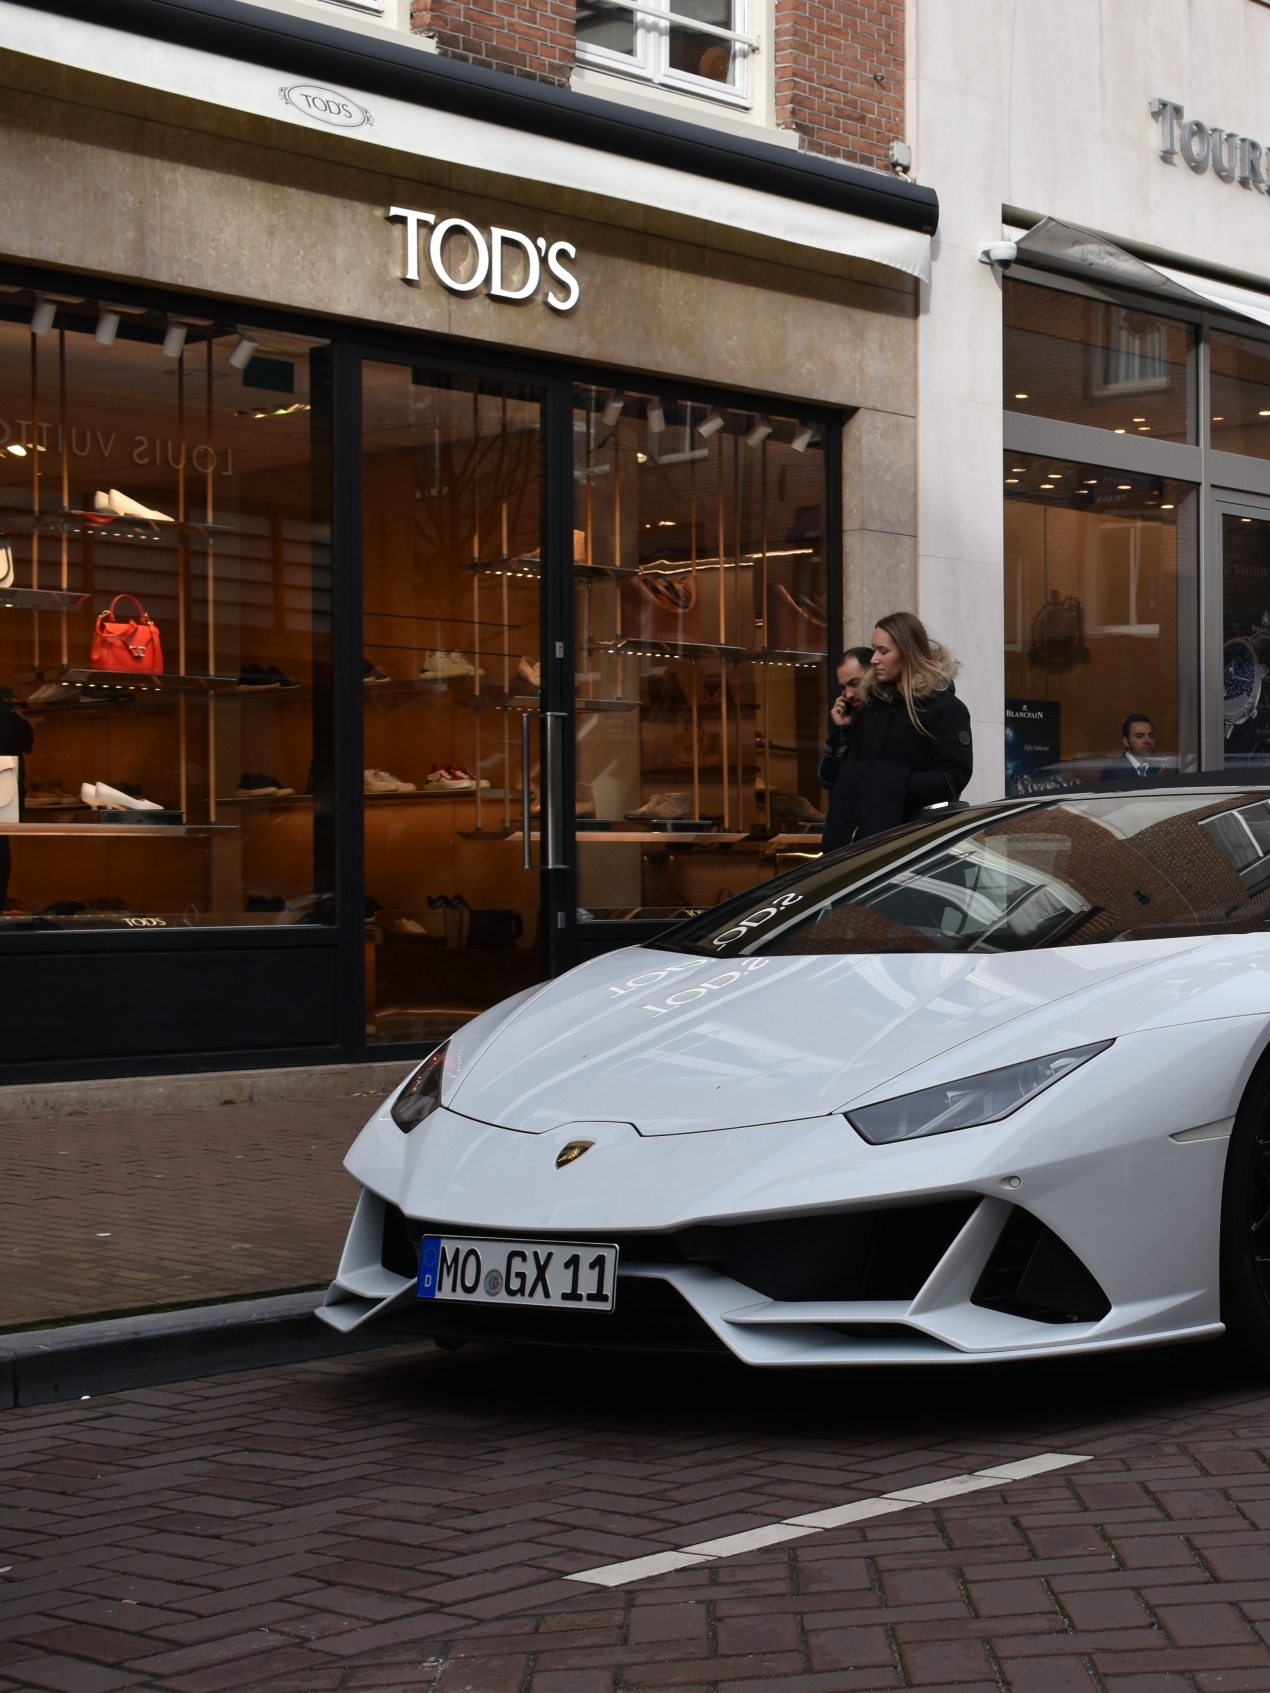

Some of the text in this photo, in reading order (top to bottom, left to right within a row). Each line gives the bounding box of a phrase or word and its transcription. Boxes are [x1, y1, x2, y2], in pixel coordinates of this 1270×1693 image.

[300, 93, 353, 119] TOD'S
[388, 206, 581, 311] TOD'S
[1005, 709, 1043, 719] BLANCPAIN
[121, 917, 167, 927] TOD'S
[424, 1274, 432, 1288] D
[437, 1246, 609, 1302] MO GX 11
